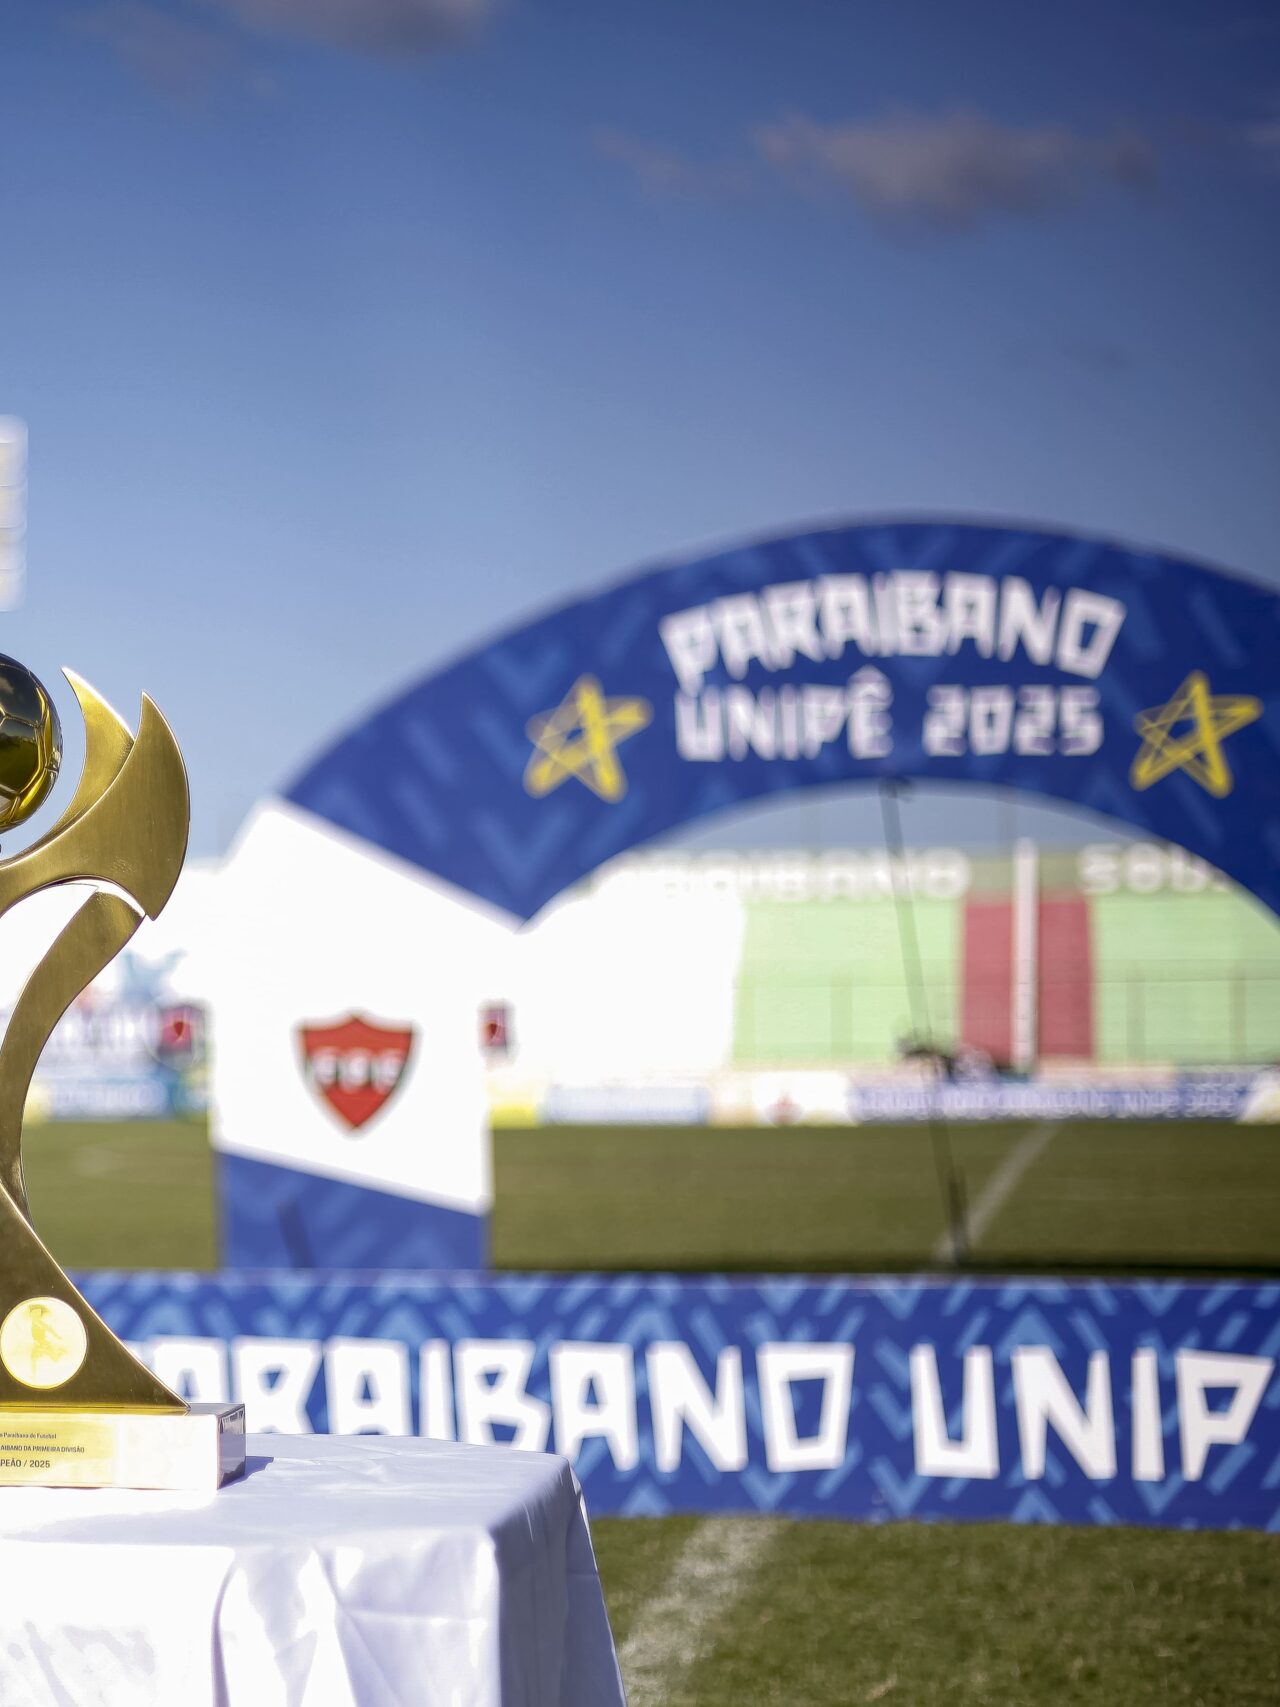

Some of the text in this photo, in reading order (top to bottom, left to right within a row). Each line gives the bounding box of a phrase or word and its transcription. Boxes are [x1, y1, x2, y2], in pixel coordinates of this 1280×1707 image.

[659, 569, 1126, 697] PARAIBANO
[674, 664, 1105, 762] UNIPÊ 2025
[29, 1458, 51, 1469] 2025
[128, 1337, 1275, 1482] ARAIBANO UNIP
